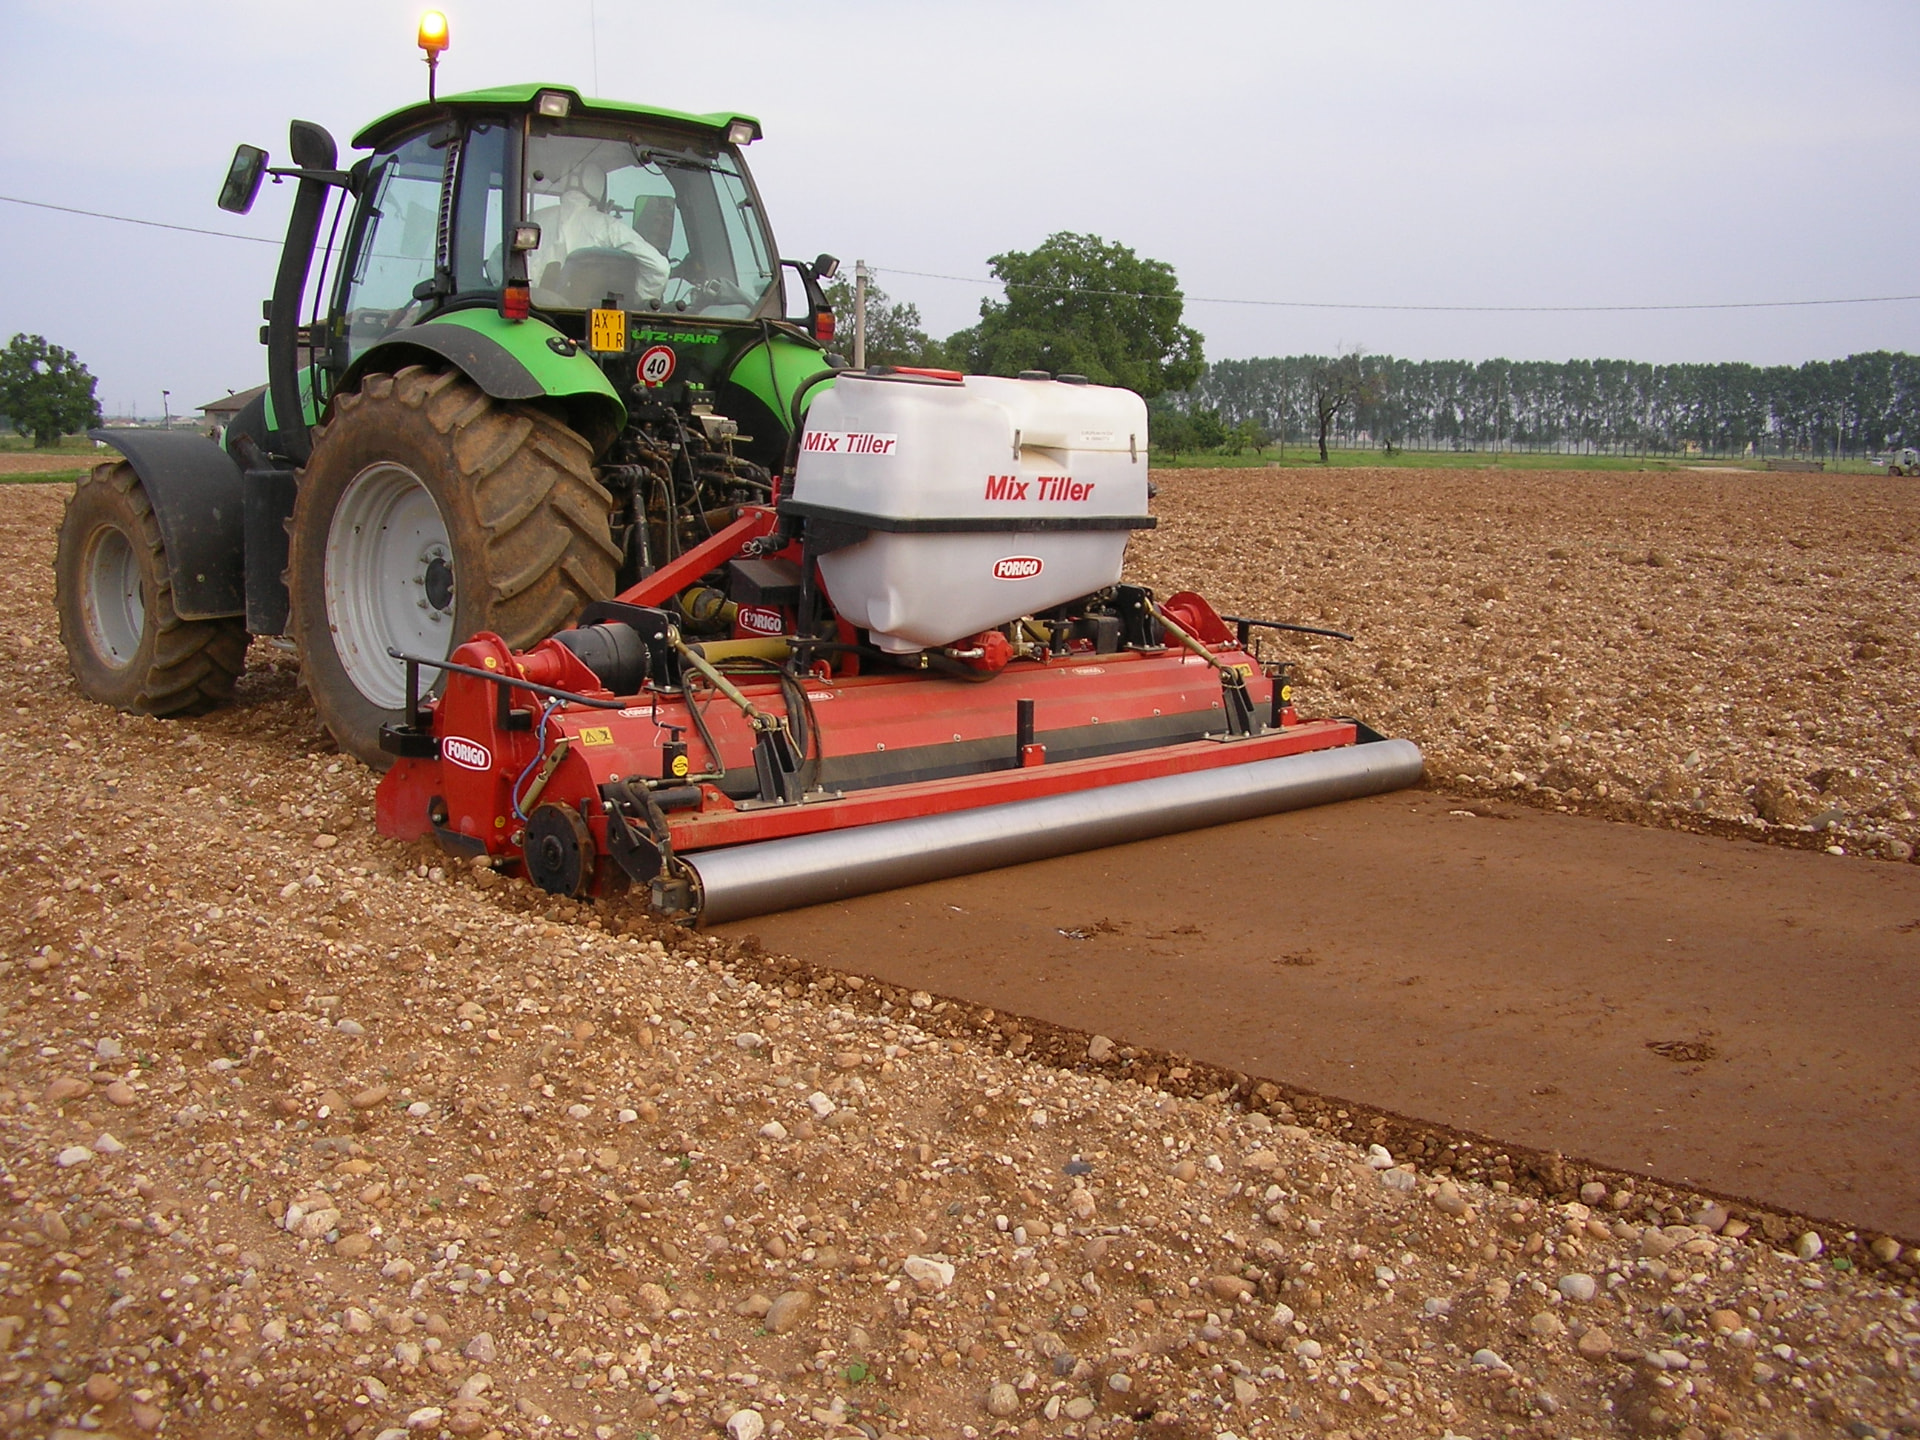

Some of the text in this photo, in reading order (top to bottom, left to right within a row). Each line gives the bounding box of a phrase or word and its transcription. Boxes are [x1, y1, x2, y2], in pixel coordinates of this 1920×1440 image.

[594, 312, 608, 329] AX
[631, 330, 719, 344] UTZ-FAHR
[647, 358, 666, 375] 40
[804, 432, 895, 453] Mix Tiller
[985, 475, 1095, 501] Mix Tiller
[997, 560, 1038, 576] FORIGO
[448, 740, 486, 766] FORIGO
